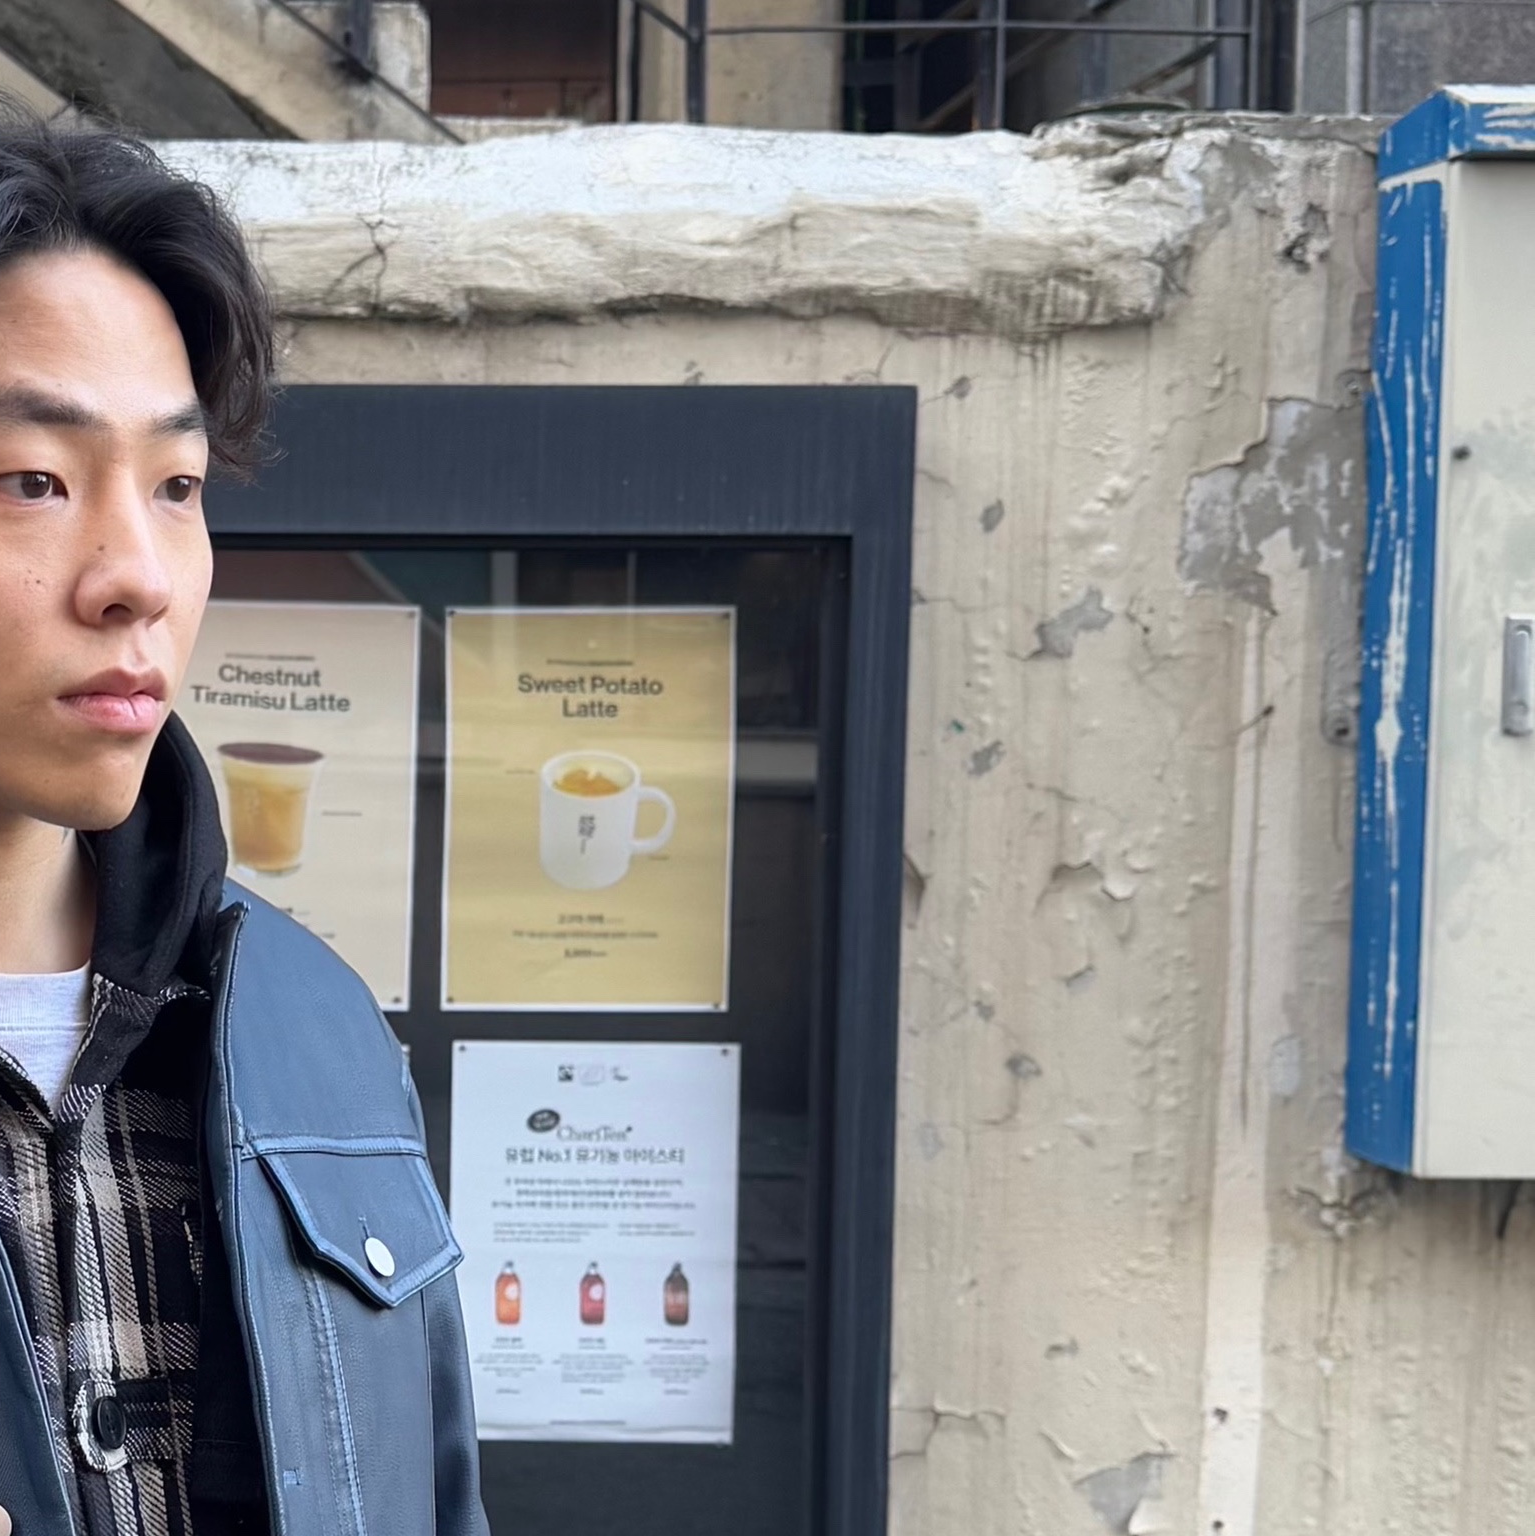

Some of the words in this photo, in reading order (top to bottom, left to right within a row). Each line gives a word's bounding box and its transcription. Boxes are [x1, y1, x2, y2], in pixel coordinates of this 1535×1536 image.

[218, 664, 322, 688] Chestnut
[518, 674, 585, 694] Sweet
[591, 675, 664, 696] Potato
[190, 685, 285, 710] Tiramisu
[290, 692, 351, 713] Latte
[562, 698, 619, 718] Latte
